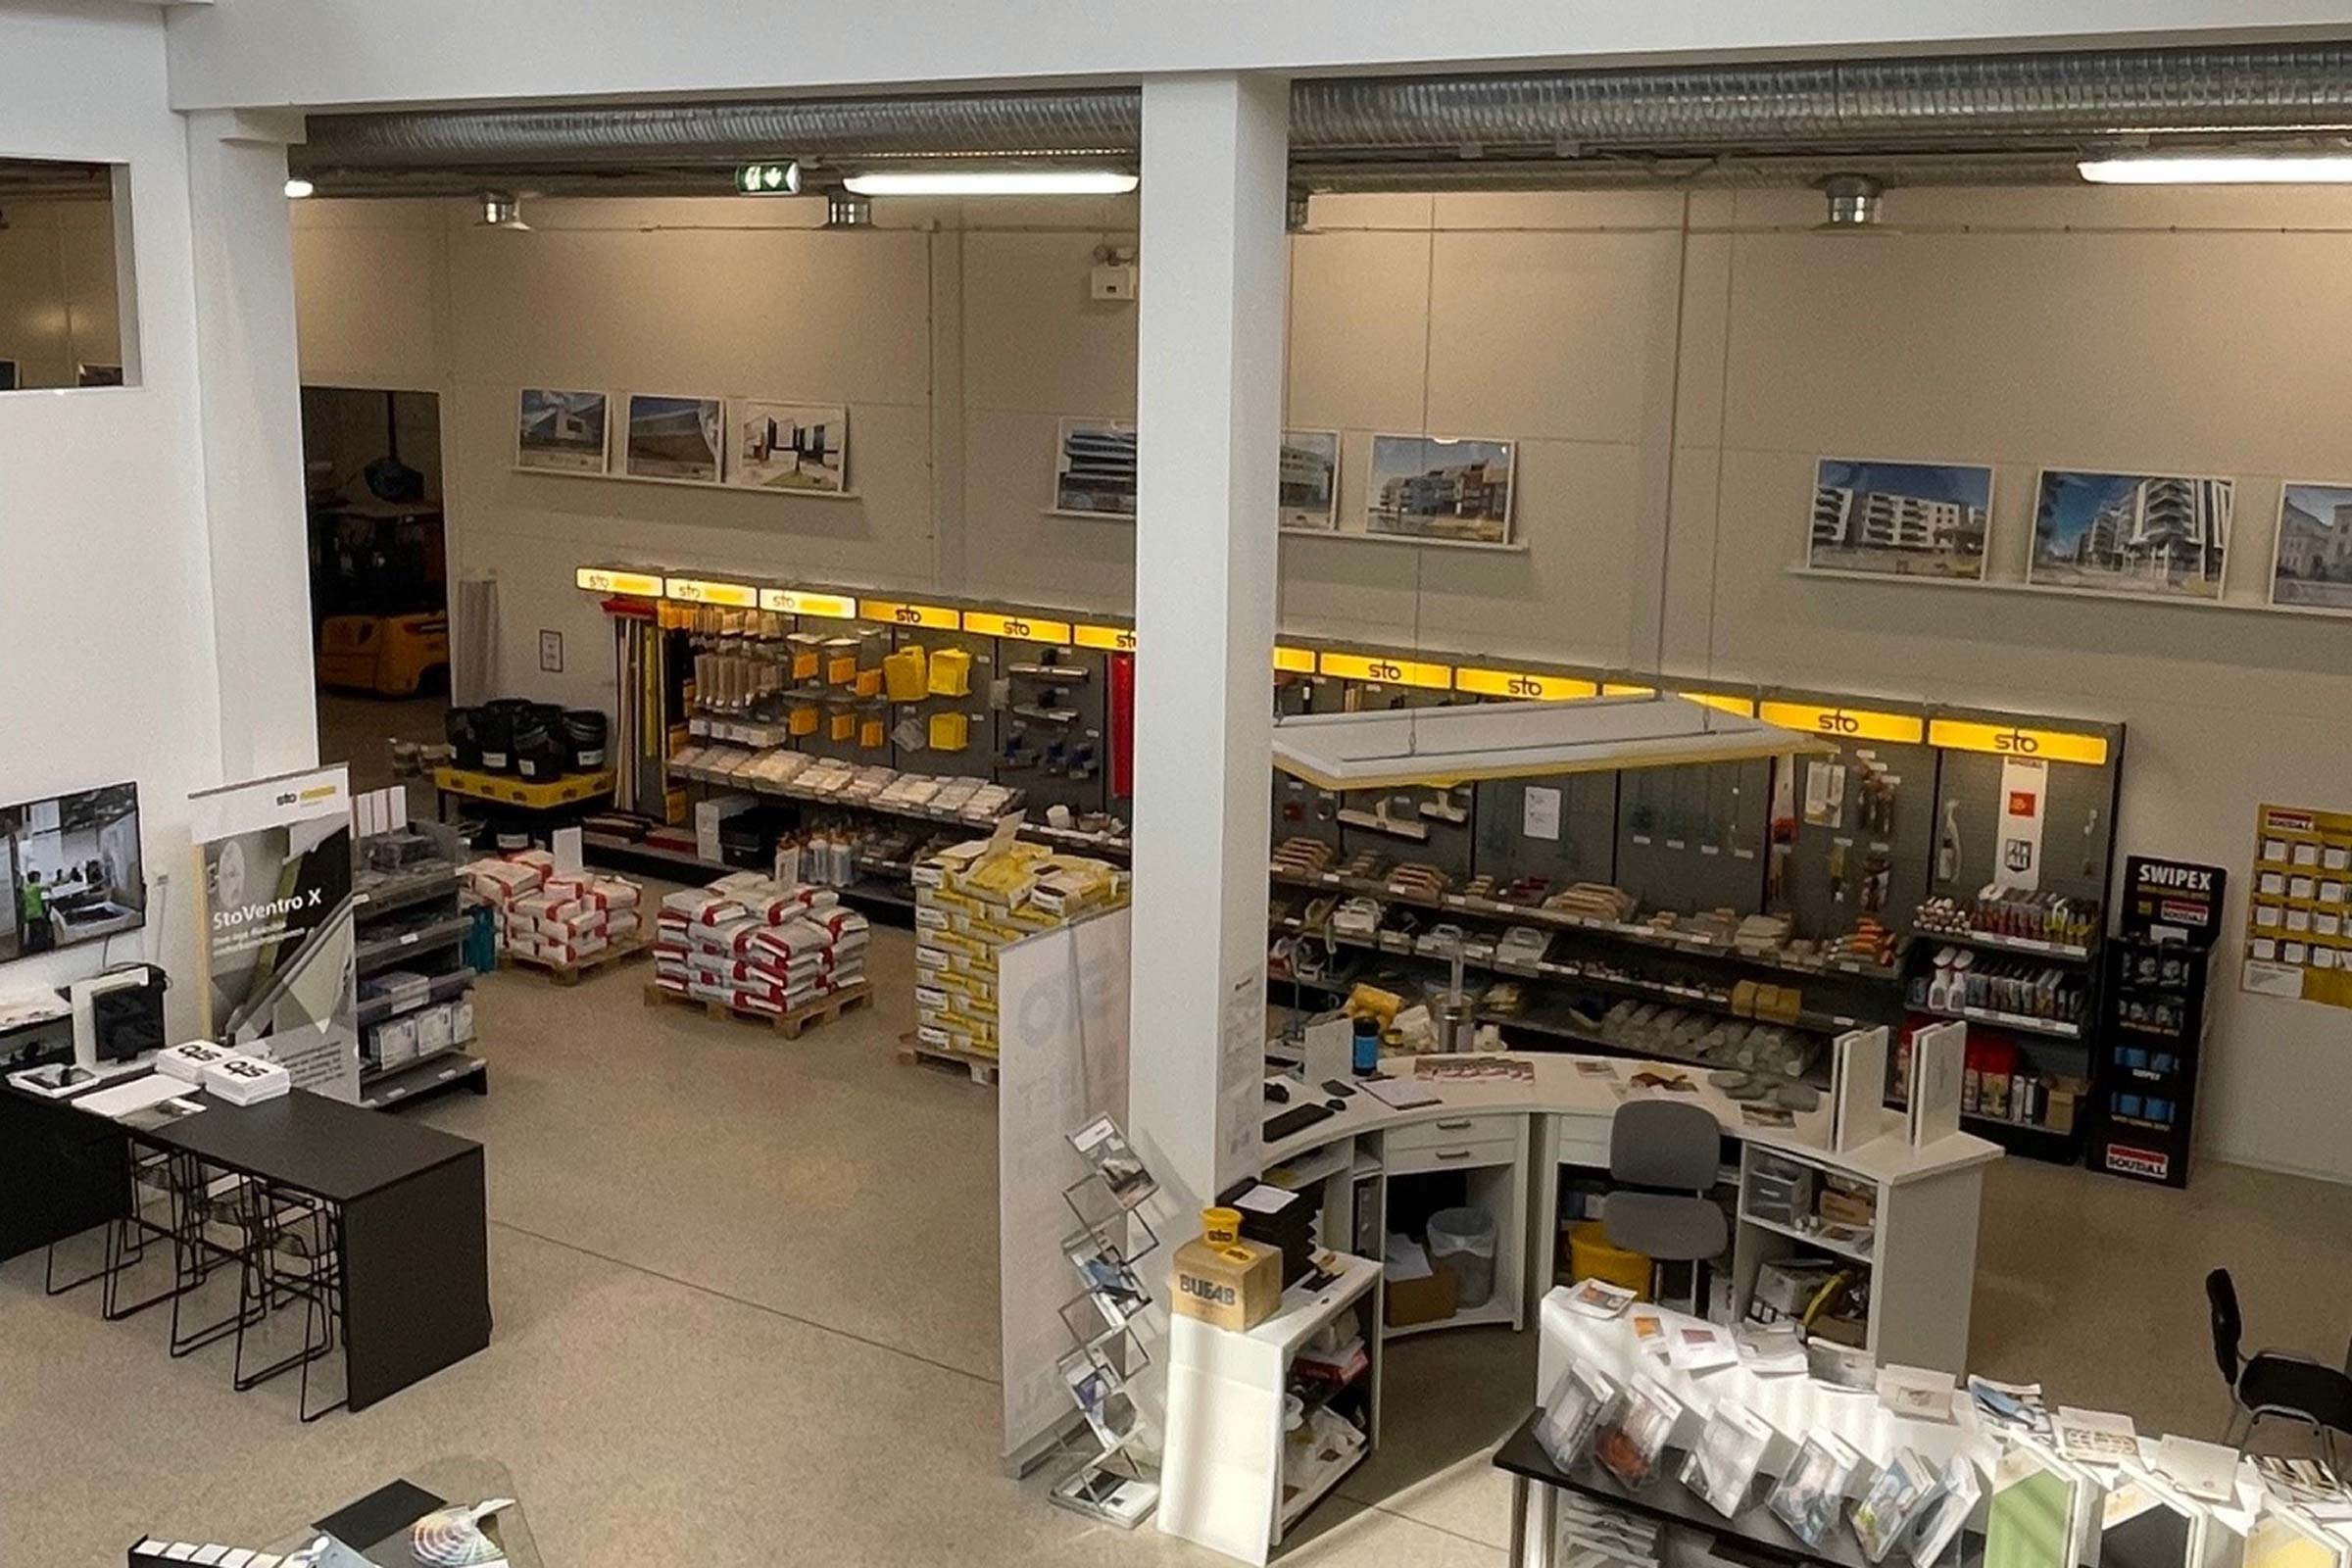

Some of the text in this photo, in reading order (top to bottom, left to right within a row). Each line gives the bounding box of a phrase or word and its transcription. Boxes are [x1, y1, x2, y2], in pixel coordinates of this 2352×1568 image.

[679, 583, 701, 599] sto
[772, 593, 796, 609] sto
[896, 604, 921, 623] sto
[1003, 617, 1030, 636] sto
[1368, 661, 1401, 681] sto
[1508, 676, 1542, 697] sto
[1818, 709, 1859, 733] sto
[1993, 728, 2038, 753] sto
[276, 792, 297, 807] sto
[2138, 863, 2212, 891] SWIPEX
[213, 888, 321, 930] StoVentro X
[1208, 1229, 1234, 1242] sto
